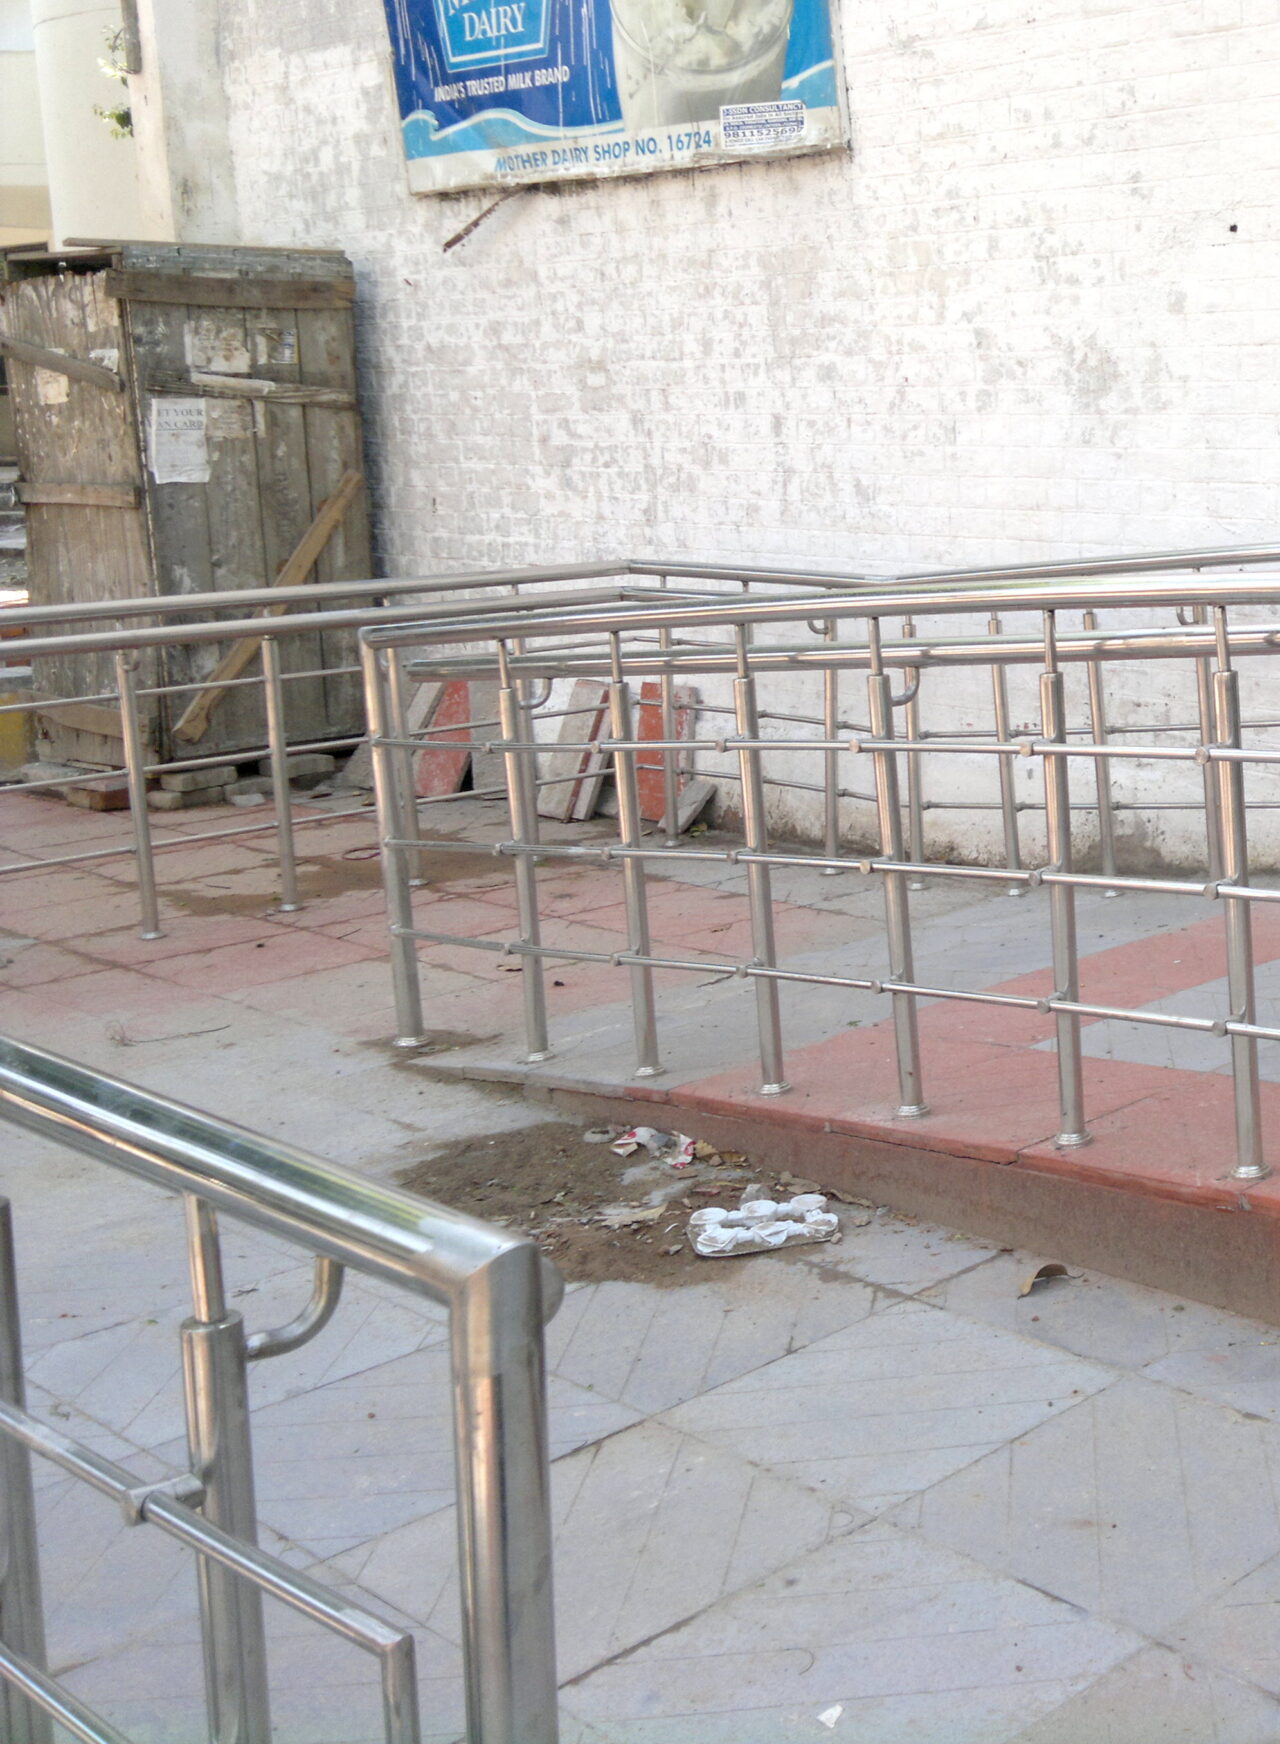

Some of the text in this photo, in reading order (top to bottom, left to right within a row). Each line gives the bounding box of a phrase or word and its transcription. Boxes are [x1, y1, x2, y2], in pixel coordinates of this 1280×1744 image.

[463, 2, 525, 41] DAIRY
[466, 76, 506, 96] TRUSTED
[507, 71, 532, 90] MILK
[534, 65, 570, 86] BRAND
[494, 151, 549, 173] MOTHER
[552, 146, 589, 166] DAIRY
[594, 140, 631, 161] SHOP
[635, 137, 662, 156] NO.
